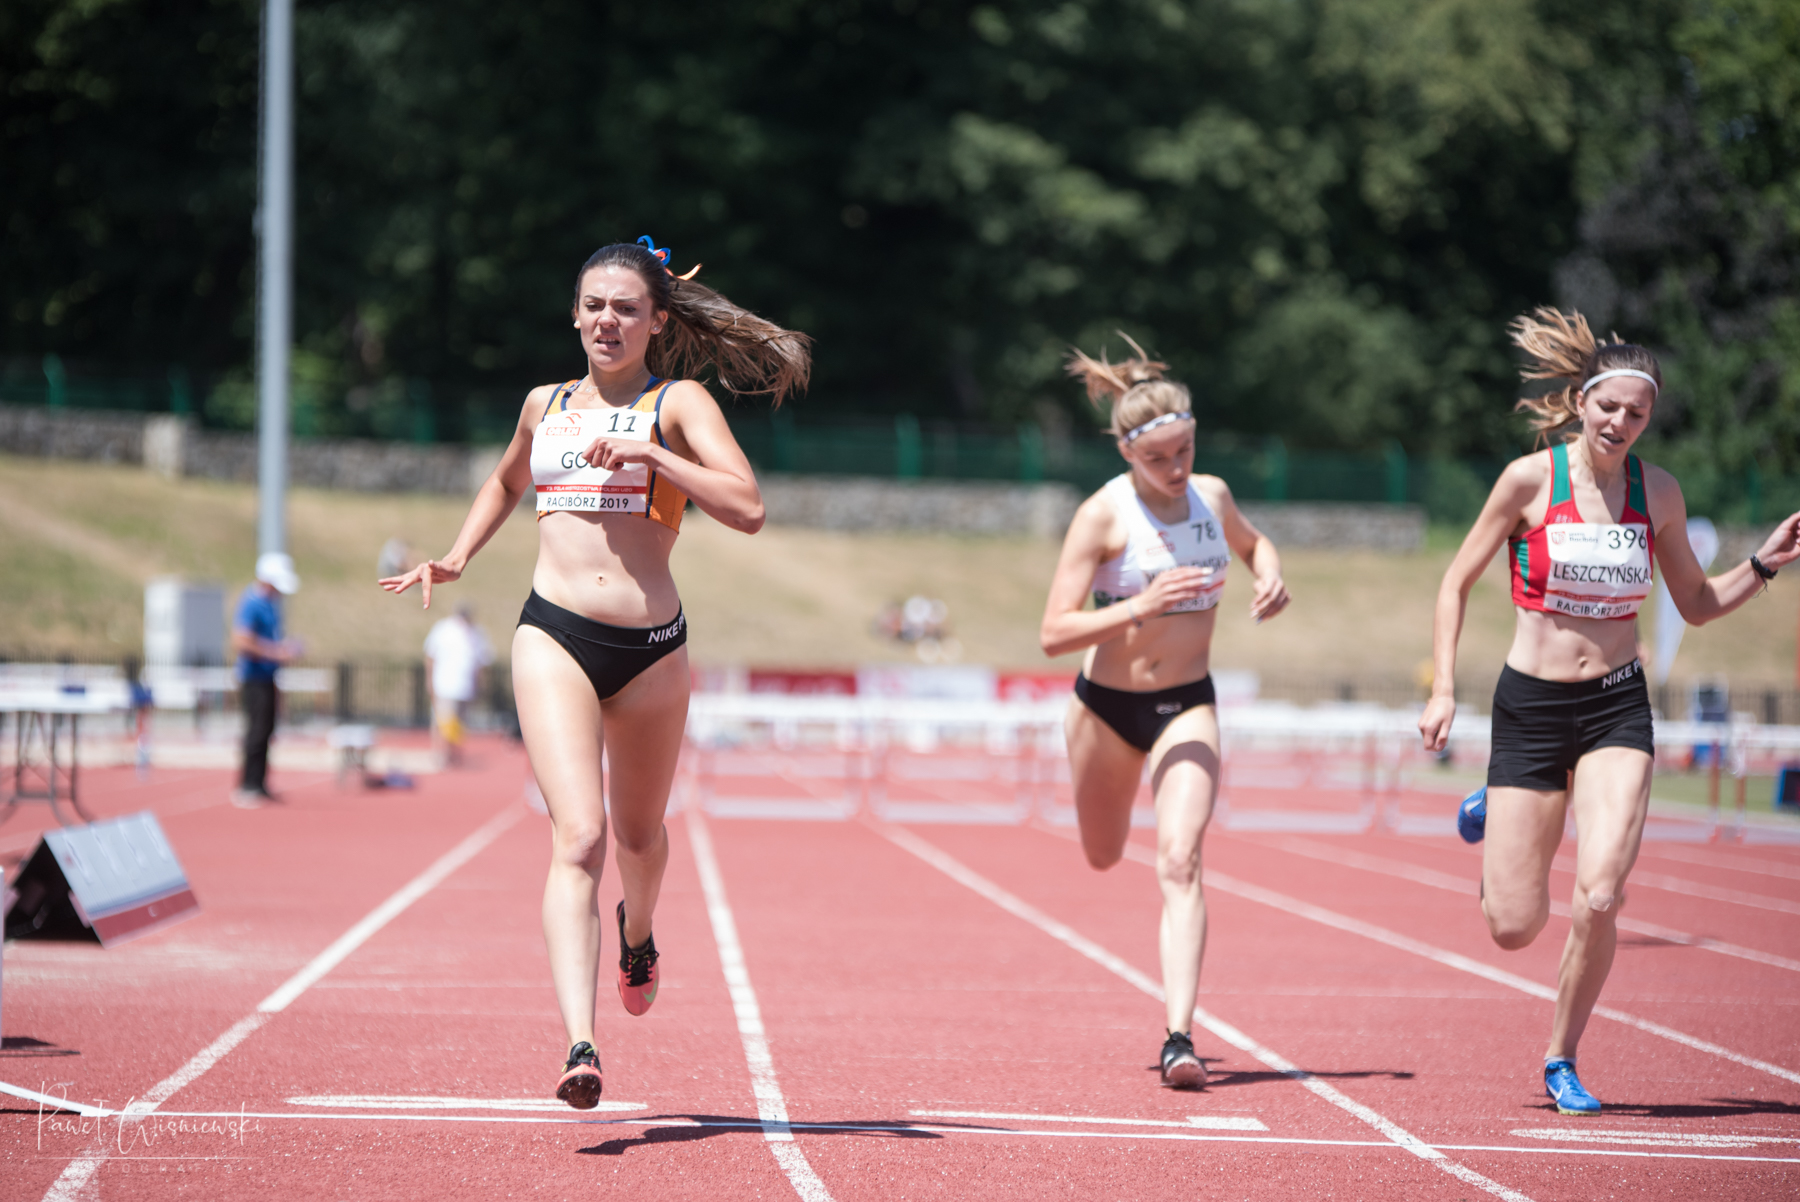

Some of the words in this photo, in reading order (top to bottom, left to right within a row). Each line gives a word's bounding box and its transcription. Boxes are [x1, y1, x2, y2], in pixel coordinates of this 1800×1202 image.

[607, 412, 637, 433] 11
[546, 493, 596, 508] RACIBÓRZ
[599, 497, 629, 509] 2019
[1191, 521, 1217, 544] 78
[1607, 528, 1647, 550] 396
[1553, 563, 1649, 584] LESZCZYŃSKA
[1556, 599, 1611, 617] RACIBÓRZ
[1613, 603, 1631, 615] 2019
[647, 621, 679, 644] NIKE
[1602, 664, 1633, 690] NIKE
